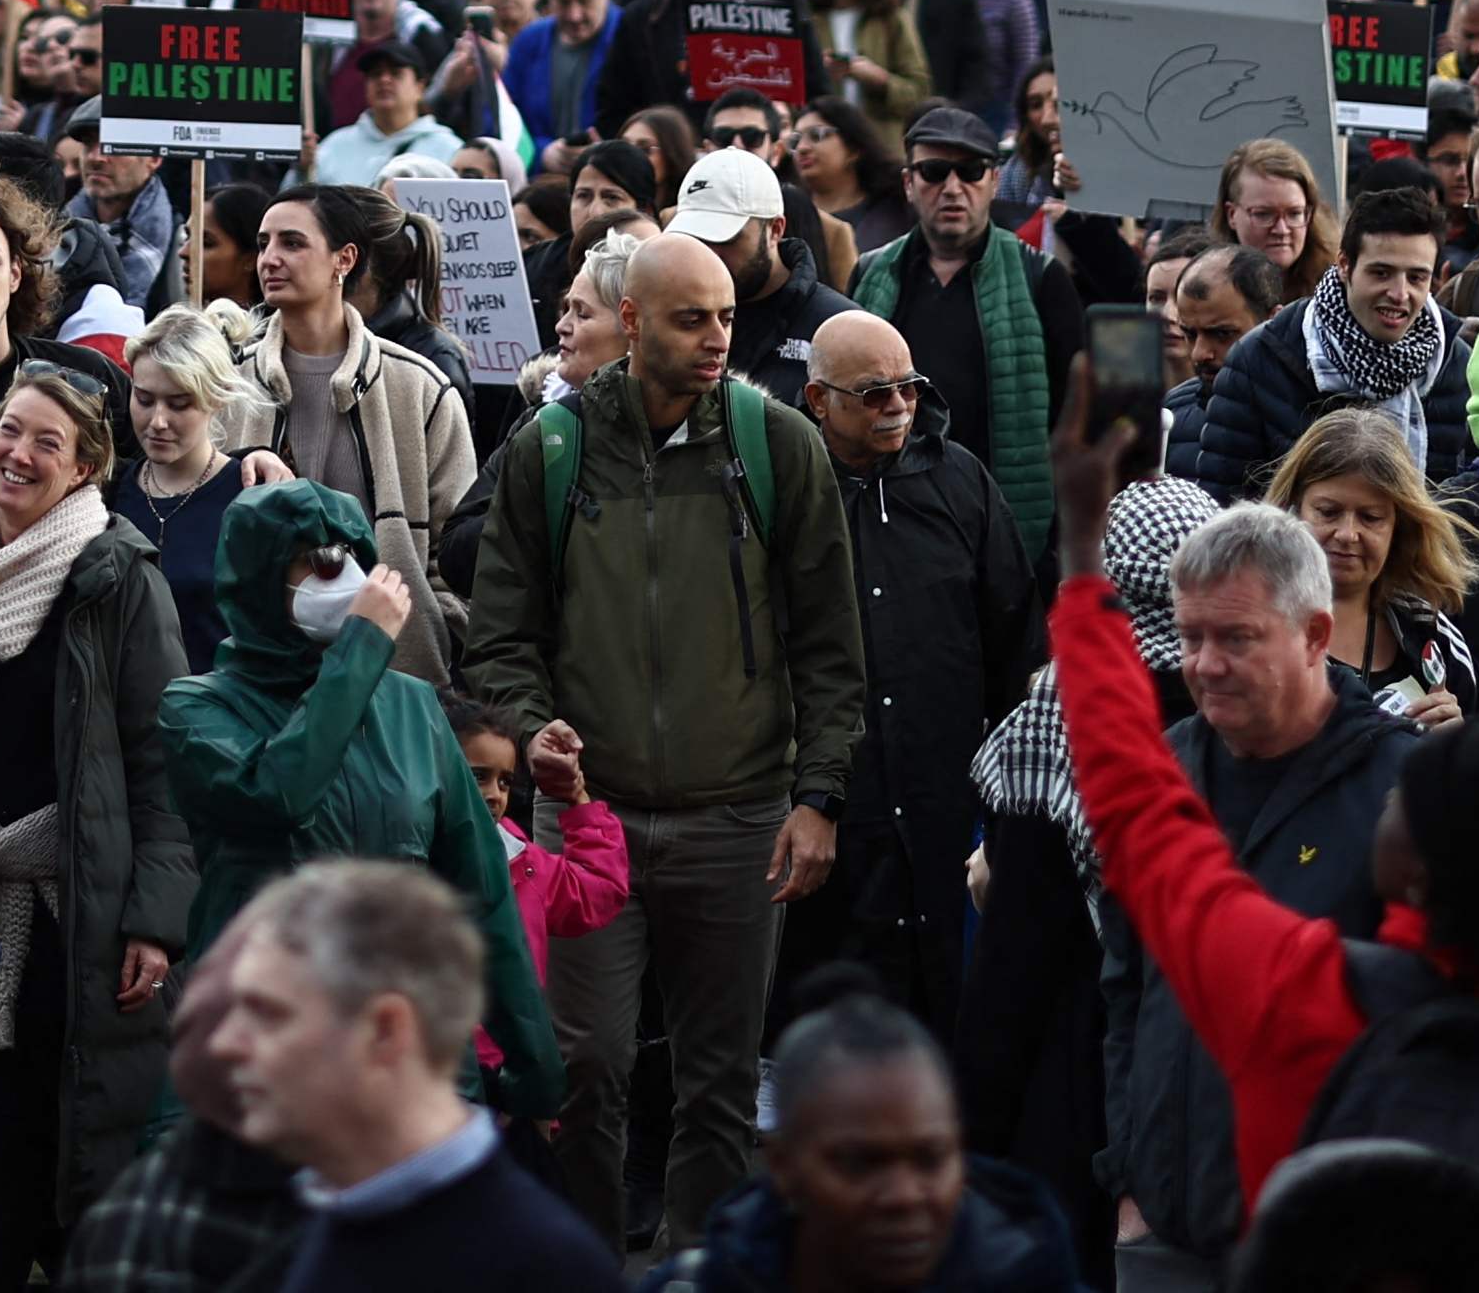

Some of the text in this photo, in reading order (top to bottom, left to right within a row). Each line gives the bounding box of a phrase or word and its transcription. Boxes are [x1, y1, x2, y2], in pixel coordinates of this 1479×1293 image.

[688, 3, 794, 35] PALESTINE
[1331, 15, 1379, 49] REE
[161, 23, 241, 62] FREE
[108, 61, 295, 103] PALESTINE
[1335, 50, 1424, 88] STINE
[173, 125, 193, 142] FOA
[407, 196, 507, 222] YOU SHOULD
[442, 287, 506, 312] OT WHEN
[465, 316, 492, 335] ARE
[468, 341, 529, 372] ILLED
